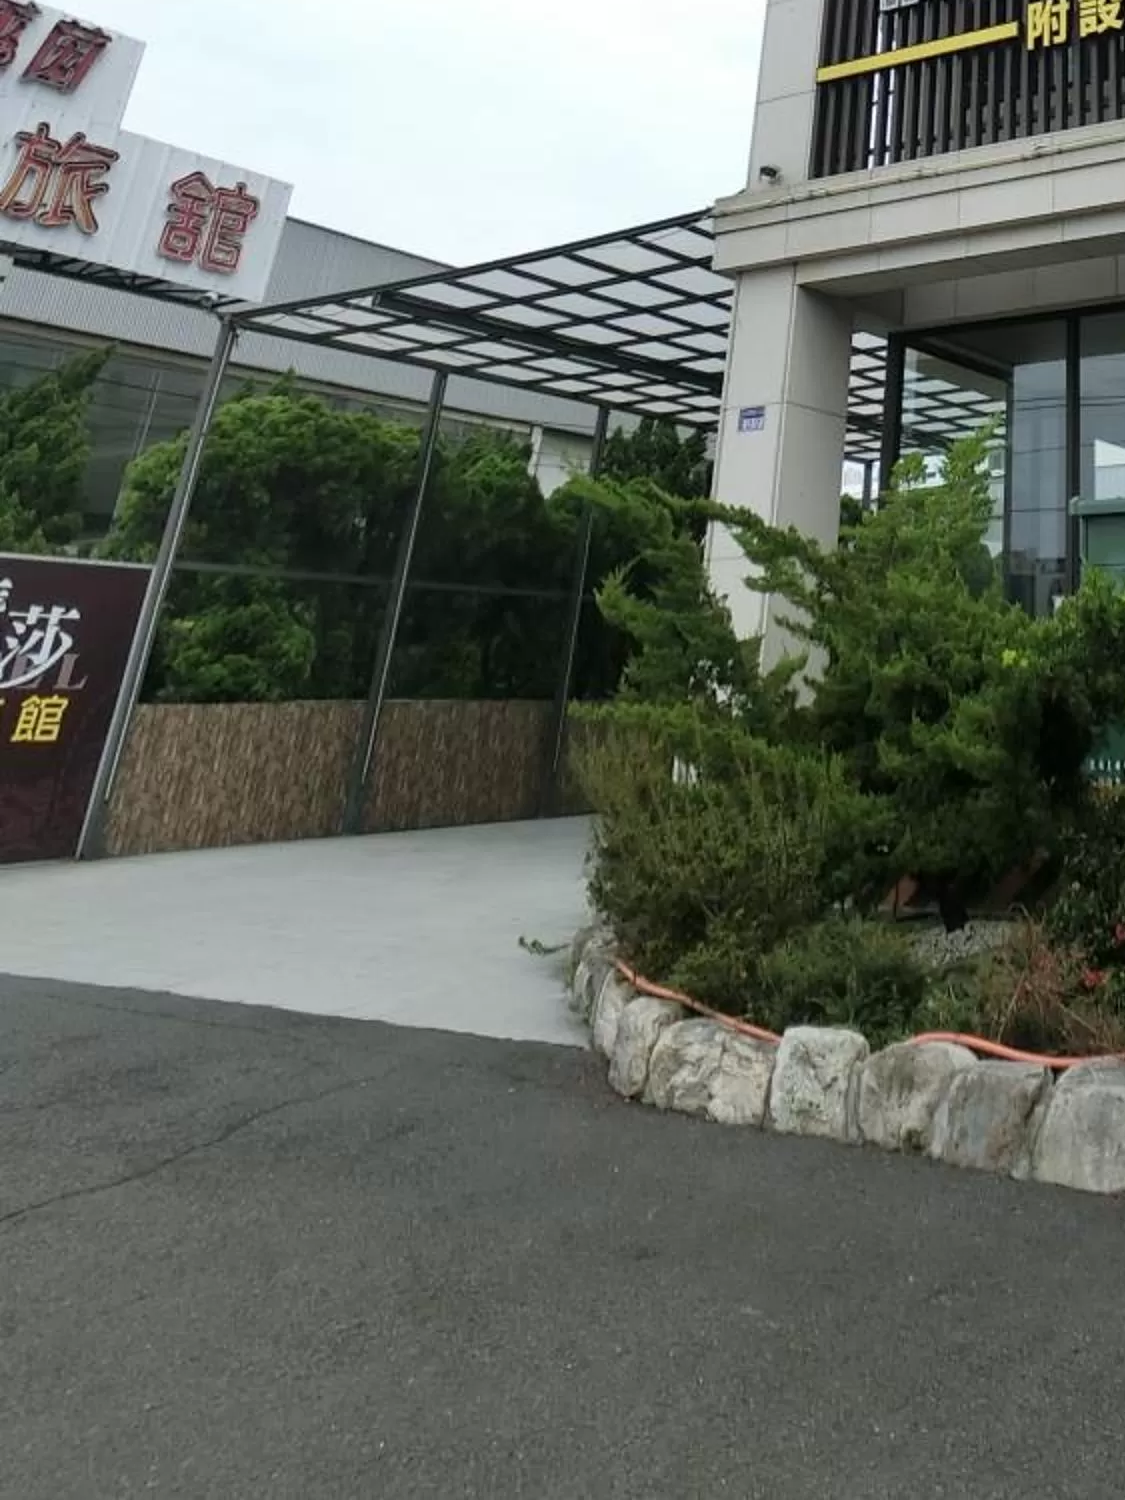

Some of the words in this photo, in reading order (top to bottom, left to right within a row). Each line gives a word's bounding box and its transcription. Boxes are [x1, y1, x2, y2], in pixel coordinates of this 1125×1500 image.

[0, 121, 261, 274] 旅館
[0, 577, 81, 689] 莎
[0, 694, 69, 743] 館
